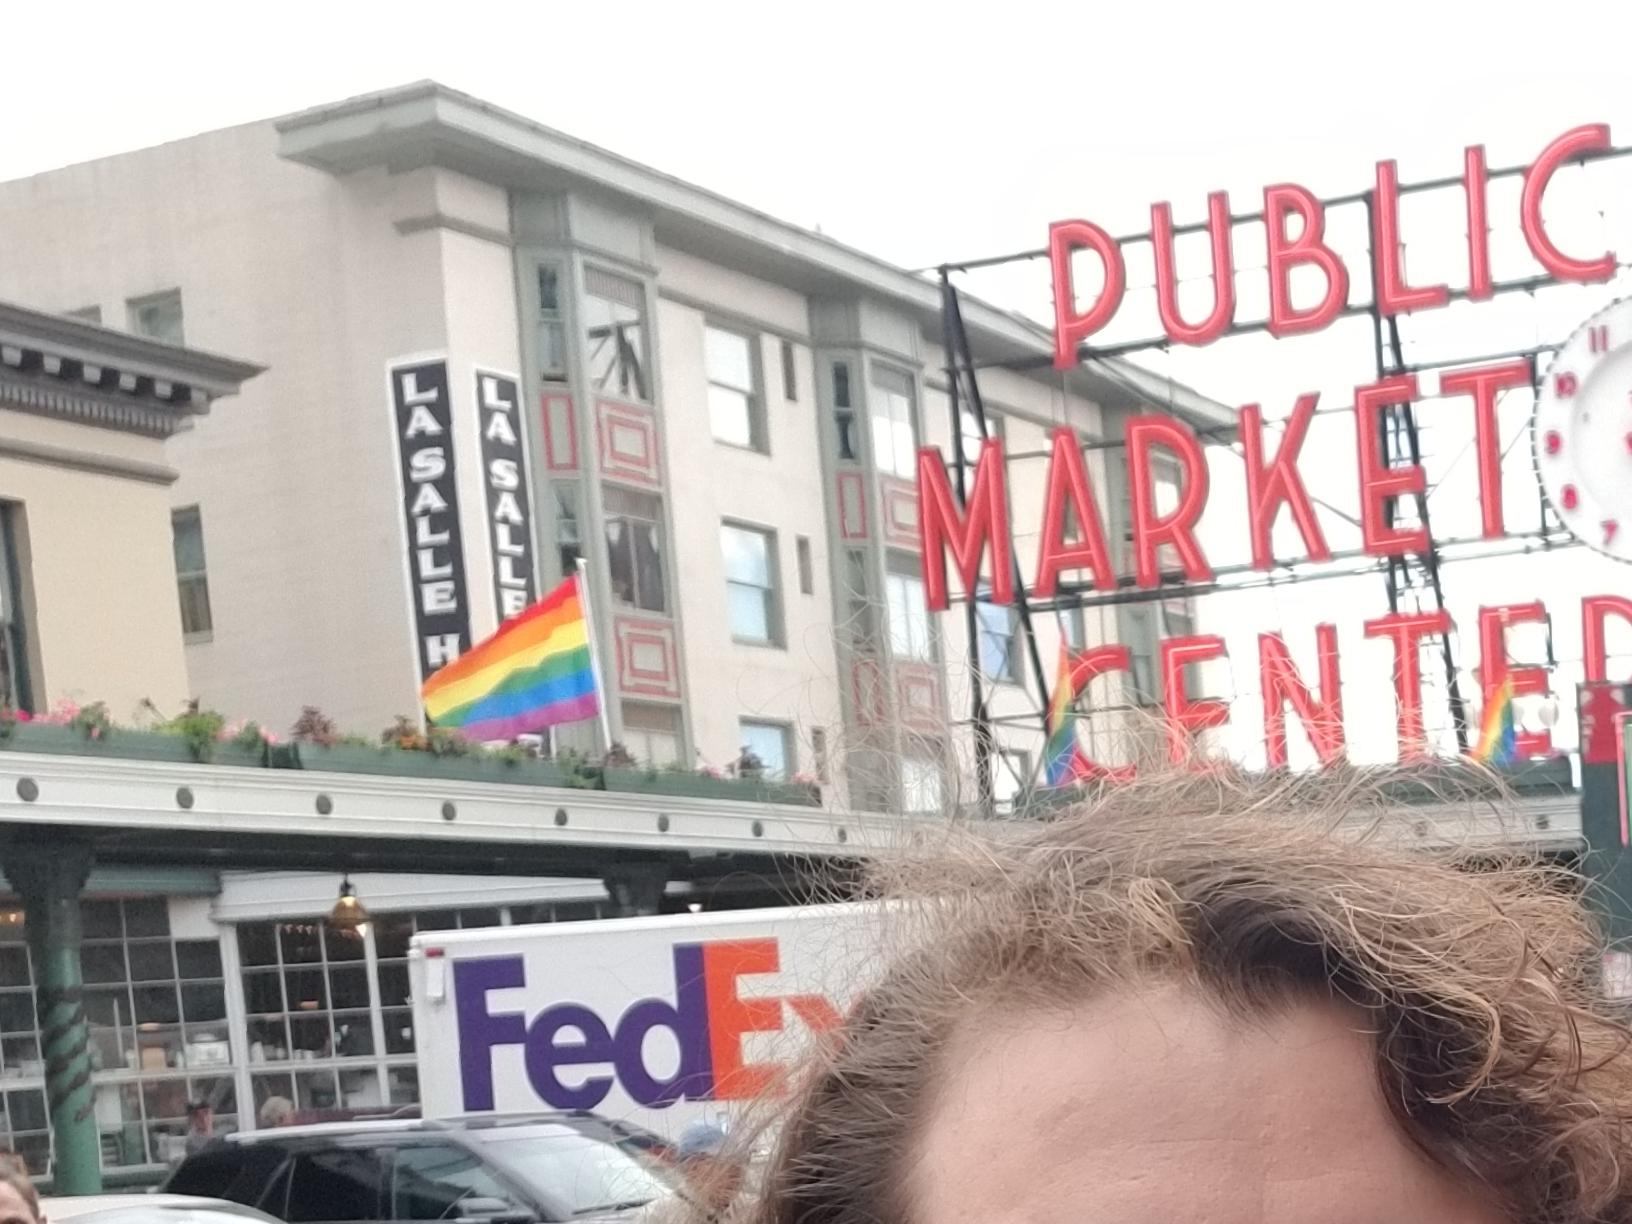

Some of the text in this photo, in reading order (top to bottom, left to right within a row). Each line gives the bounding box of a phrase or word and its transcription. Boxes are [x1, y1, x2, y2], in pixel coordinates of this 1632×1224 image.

[1048, 123, 1618, 370] PUBLIC
[1554, 371, 1578, 398] 10
[1588, 325, 1609, 353] 11
[409, 447, 457, 615] SALLE
[489, 459, 527, 619] SALLE
[916, 360, 1533, 612] MARKET
[1602, 519, 1618, 544] 7
